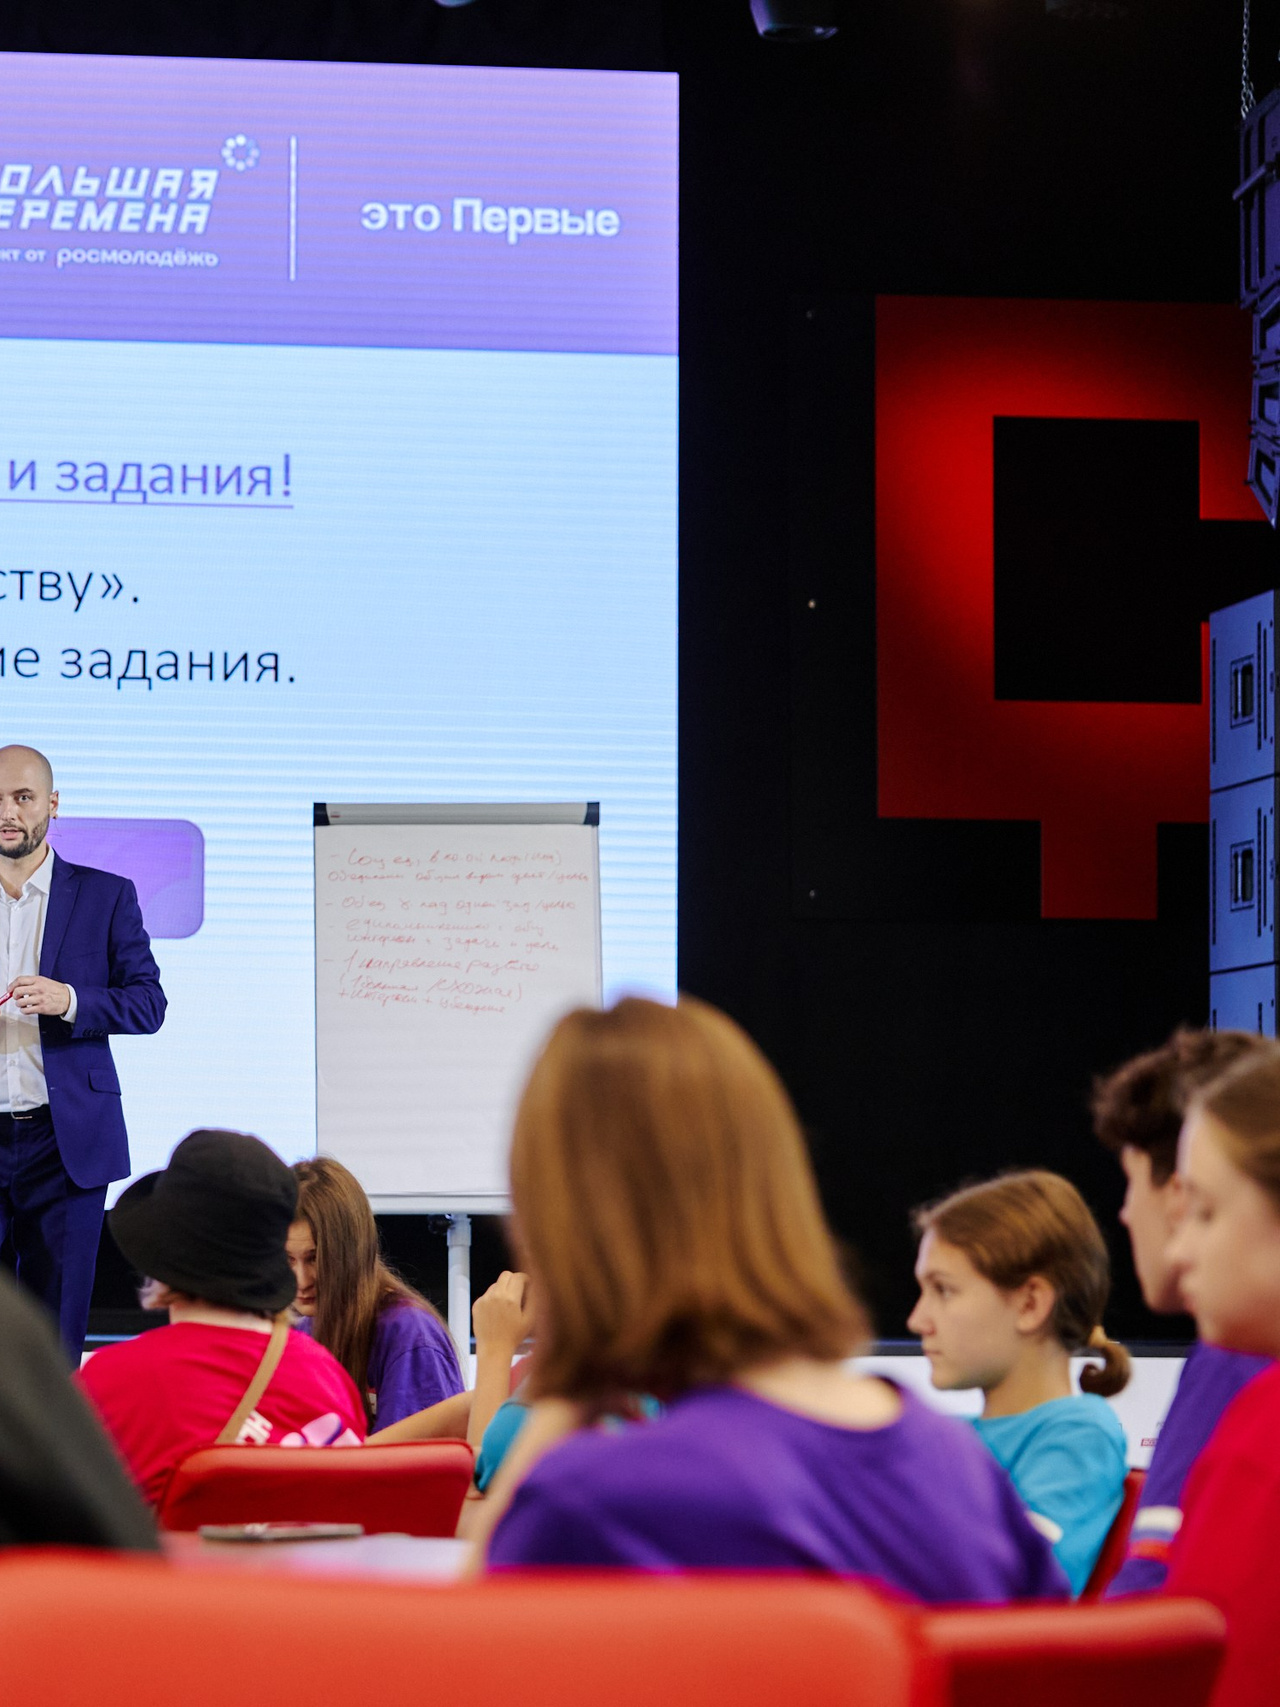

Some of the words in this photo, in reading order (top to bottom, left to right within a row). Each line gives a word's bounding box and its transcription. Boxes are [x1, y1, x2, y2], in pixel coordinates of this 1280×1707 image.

[361, 202, 441, 232] это
[452, 197, 621, 245] Первые
[24, 249, 46, 263] от
[56, 247, 220, 269] росмолодёжь
[8, 459, 37, 491] и
[54, 452, 291, 504] задания!
[60, 648, 296, 692] задания.
